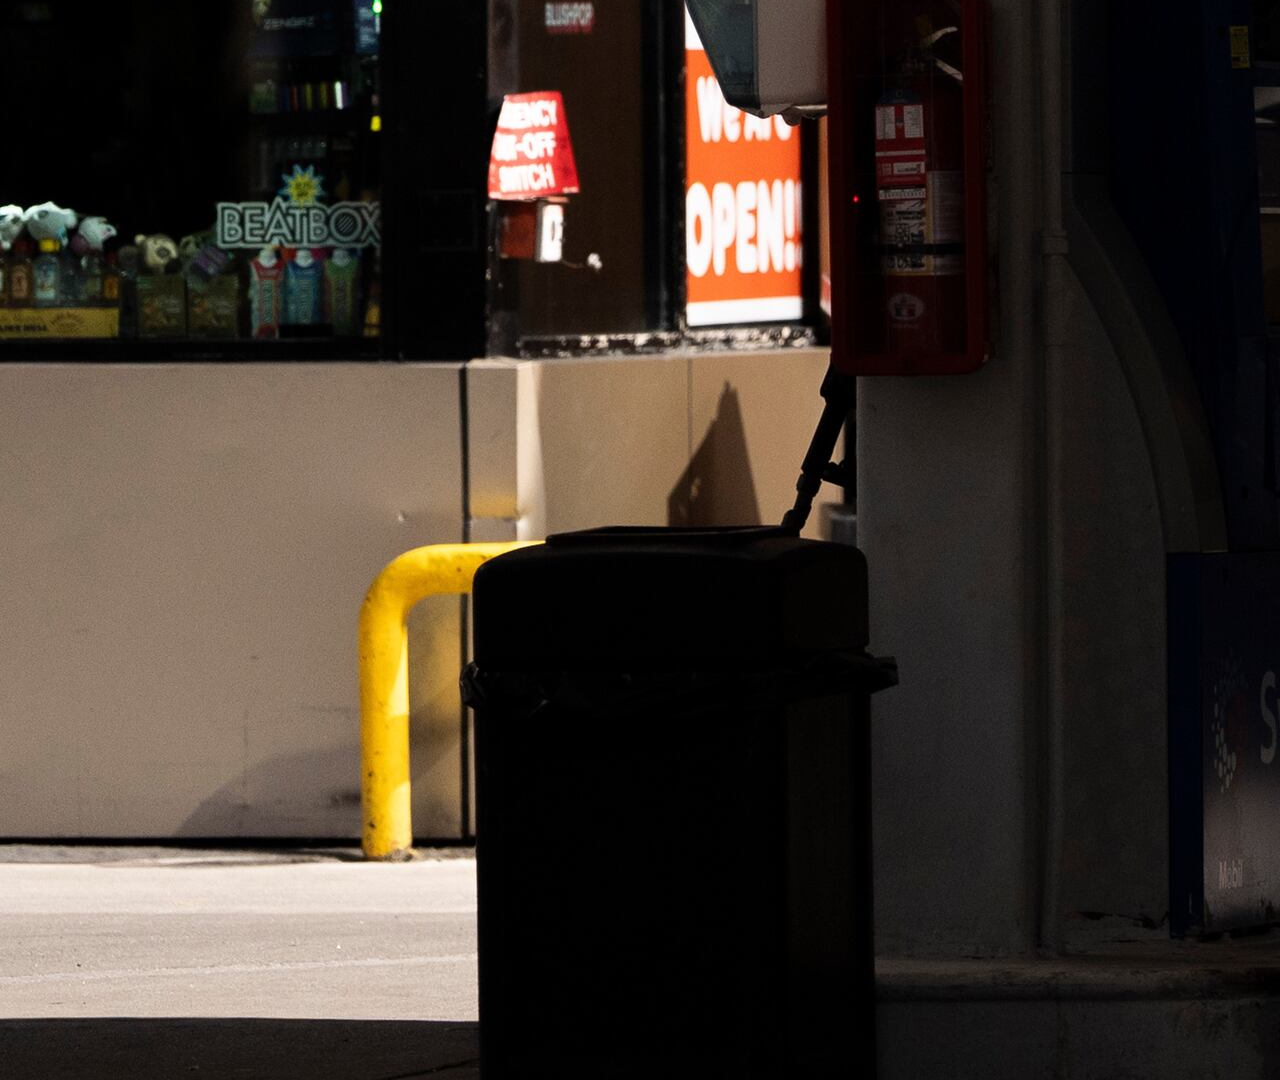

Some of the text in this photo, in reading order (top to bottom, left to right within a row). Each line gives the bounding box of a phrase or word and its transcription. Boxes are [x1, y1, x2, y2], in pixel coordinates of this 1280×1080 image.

[696, 76, 742, 143] We
[217, 197, 380, 248] BEATBOX
[1219, 860, 1243, 889] Mobil
